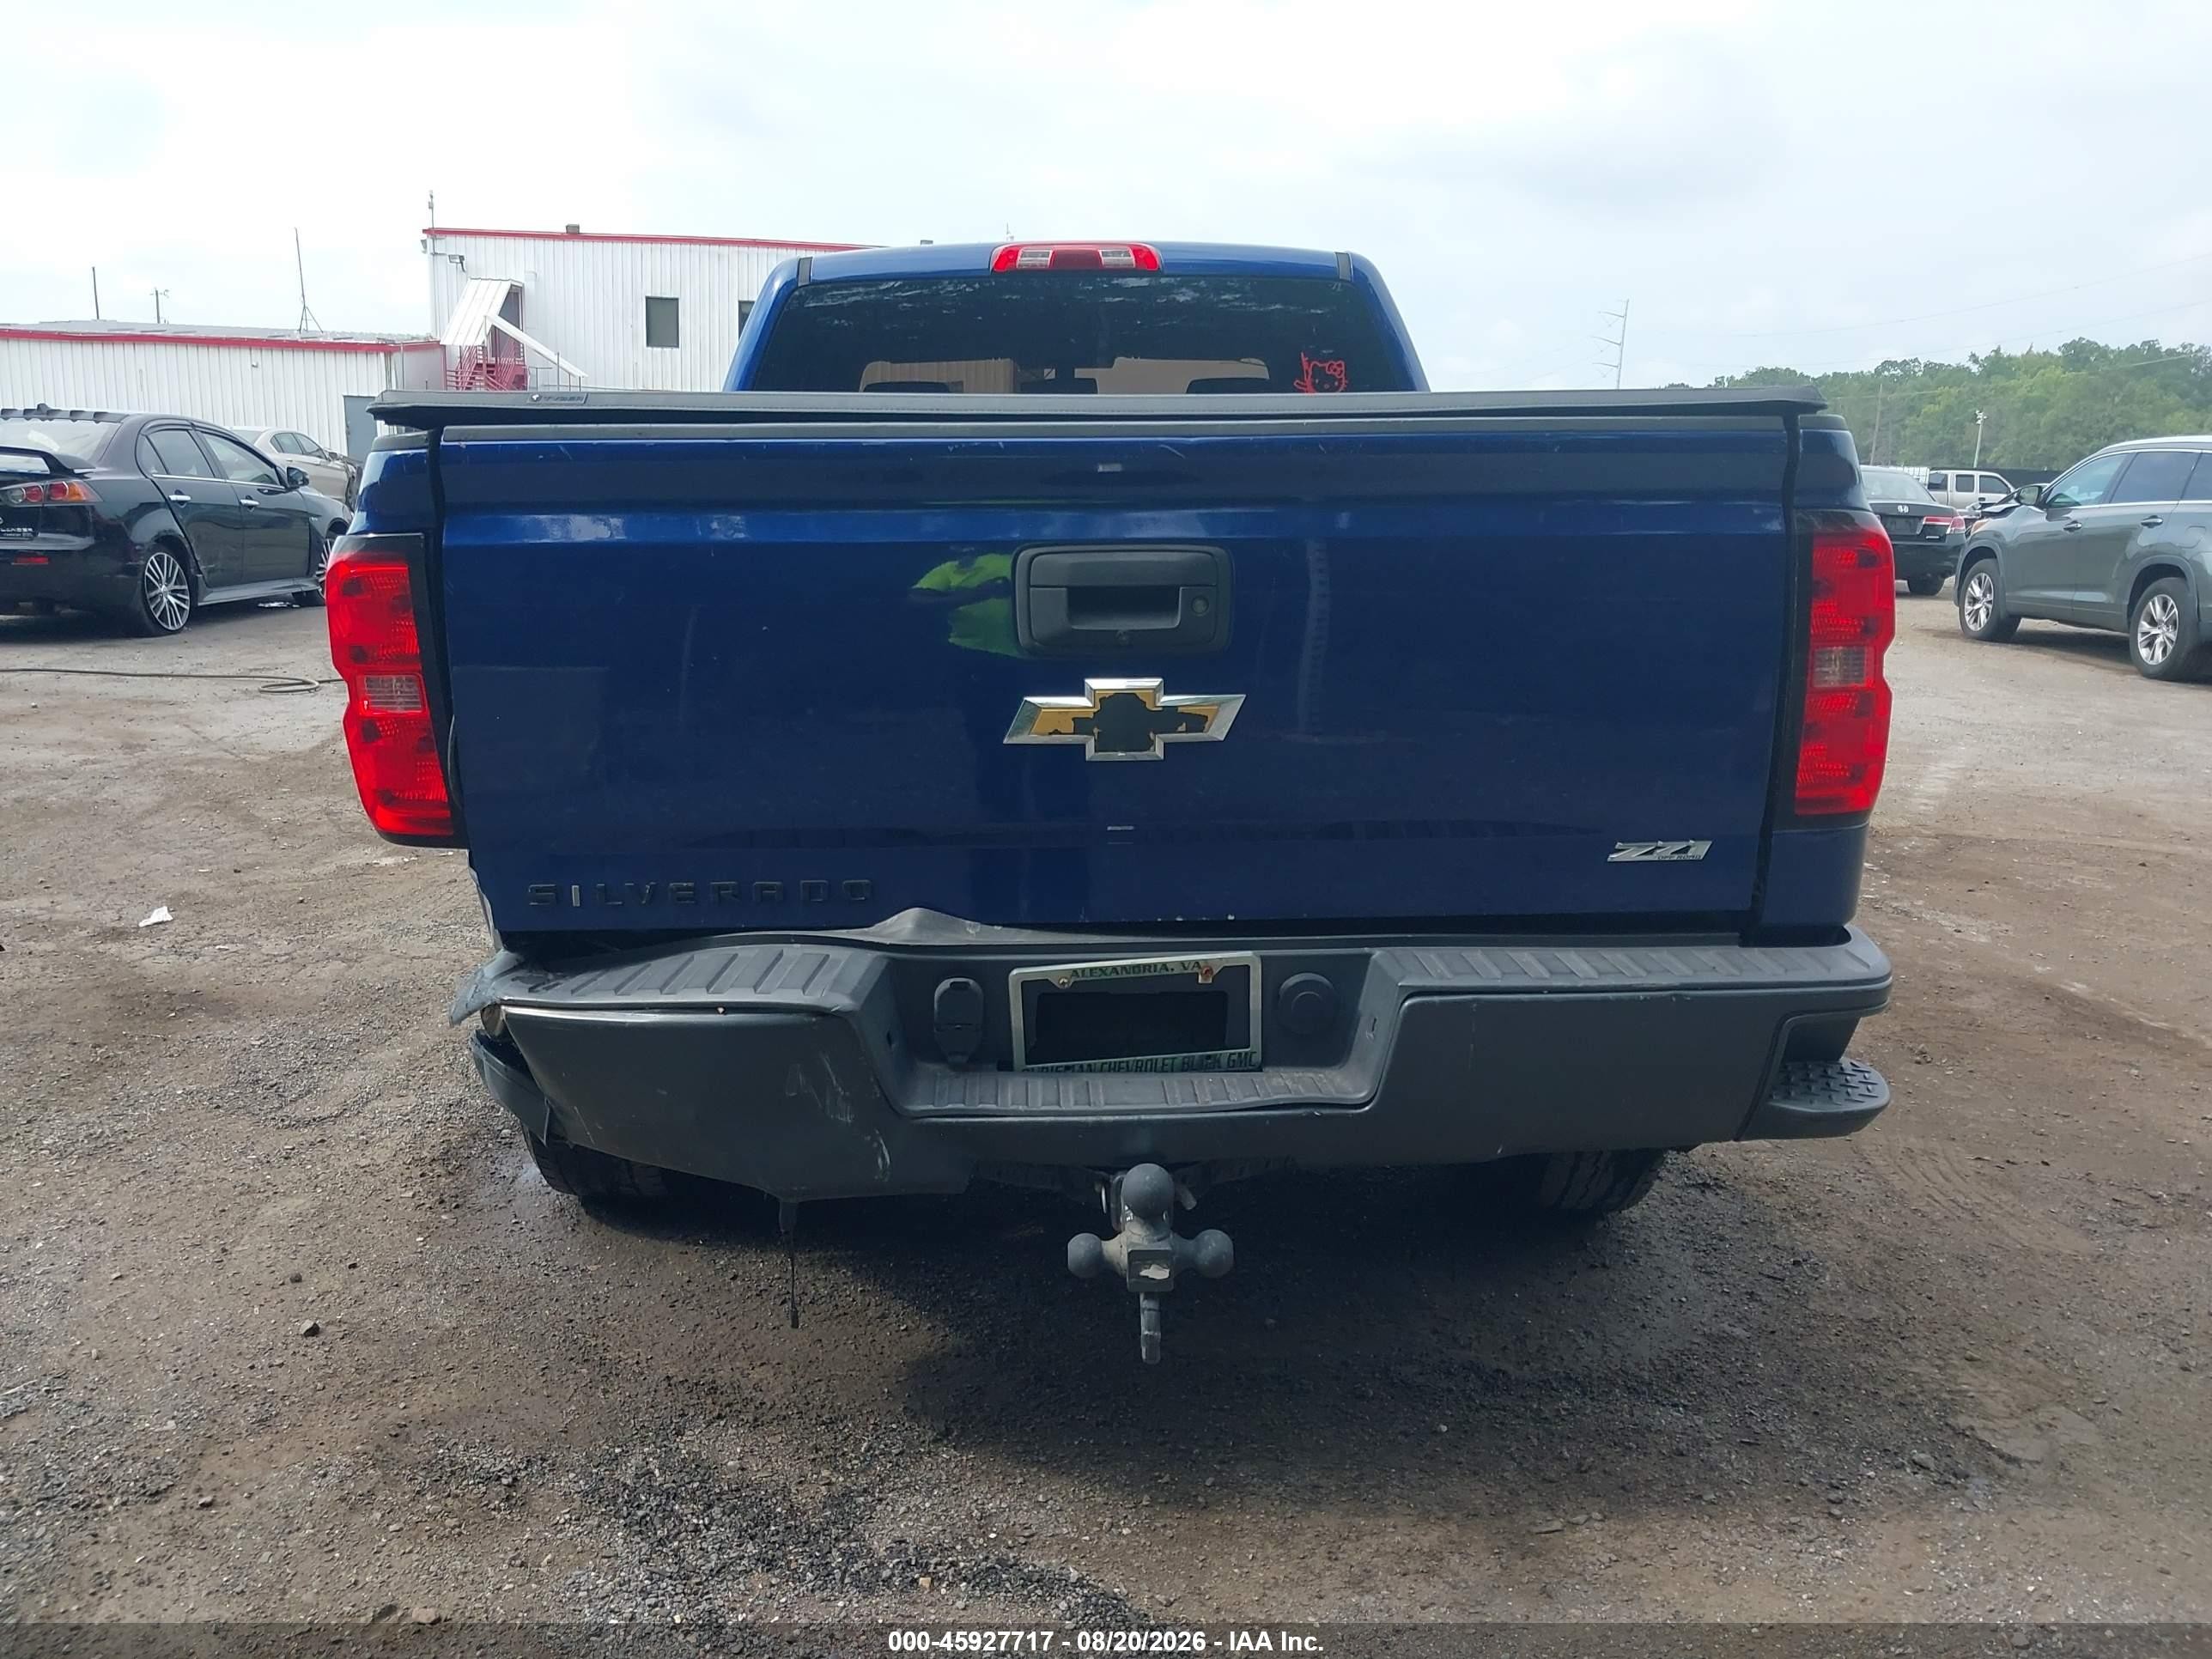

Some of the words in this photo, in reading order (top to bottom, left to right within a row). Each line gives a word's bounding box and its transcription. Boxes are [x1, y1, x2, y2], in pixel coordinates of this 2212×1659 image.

[1607, 840, 1712, 862] Z71
[528, 878, 872, 907] SILVERADO
[1100, 1056, 1176, 1073] CHEVROLET
[1227, 1051, 1258, 1068] GMC
